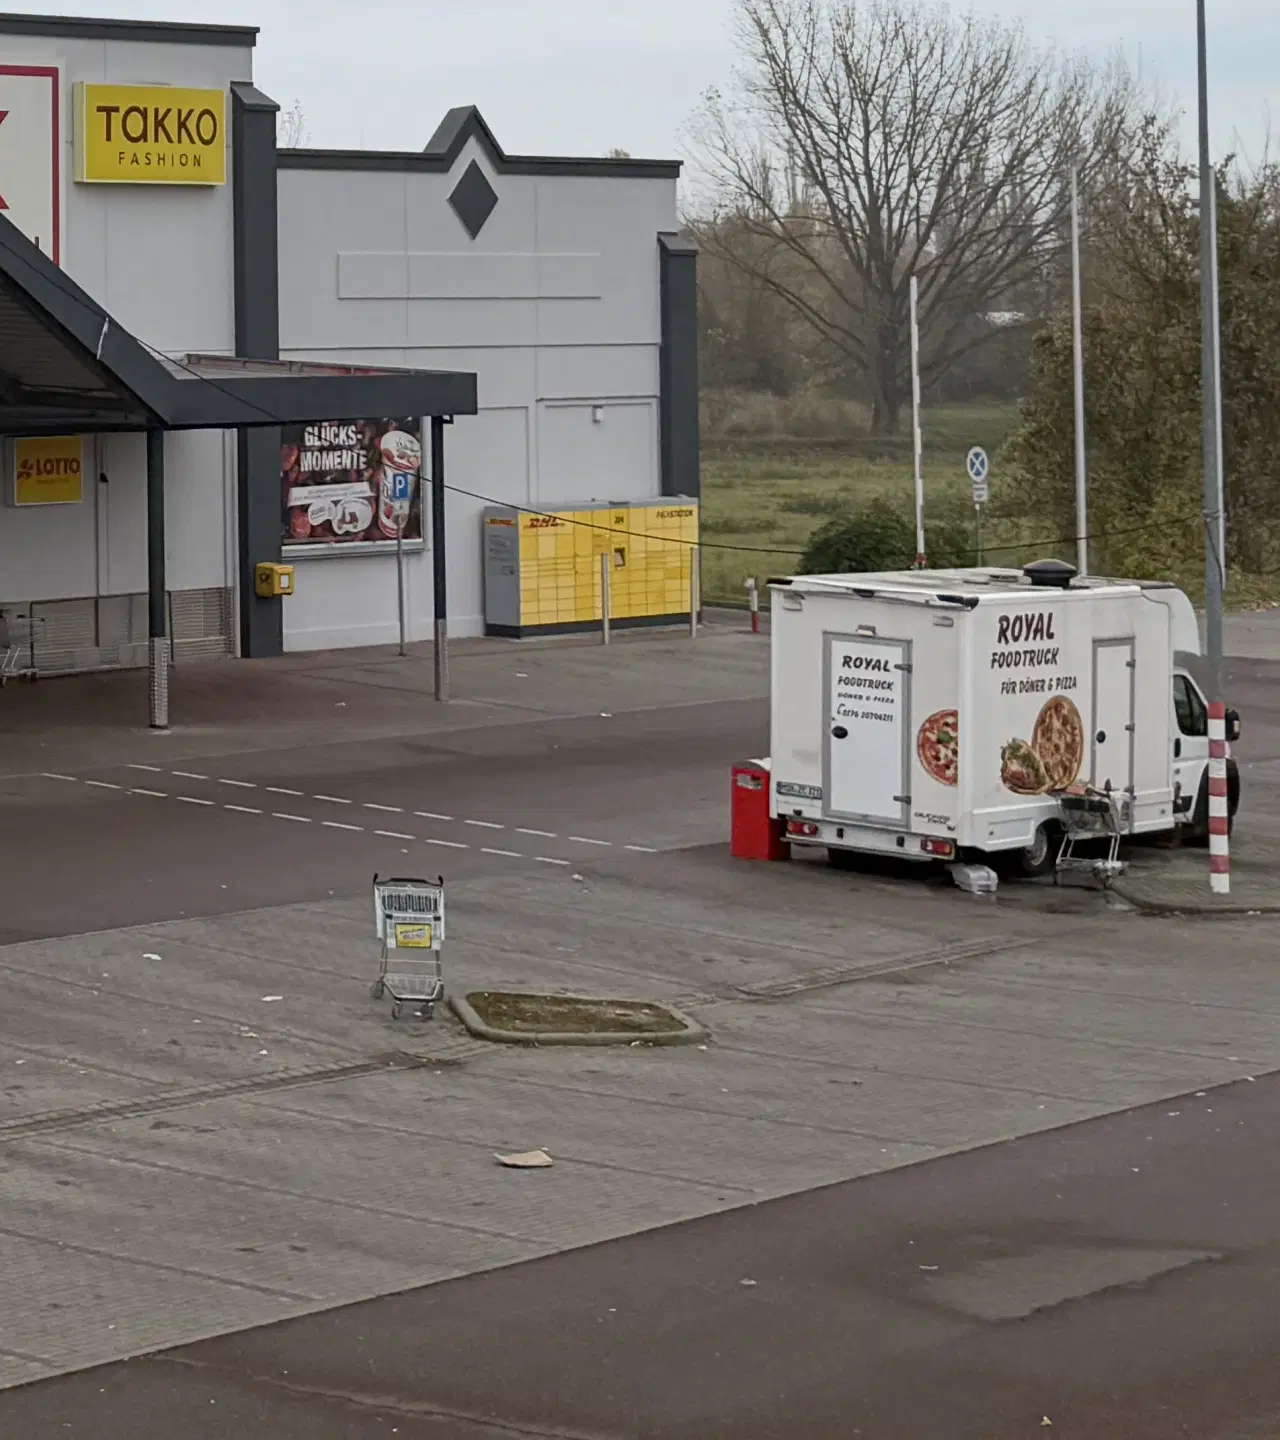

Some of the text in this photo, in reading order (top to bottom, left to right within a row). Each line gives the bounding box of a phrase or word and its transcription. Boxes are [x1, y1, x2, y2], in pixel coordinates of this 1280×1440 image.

[118, 151, 203, 168] FASHION
[36, 456, 81, 476] LOTTO
[300, 449, 368, 472] MOMENTE
[997, 612, 1055, 645] ROYAL
[842, 655, 891, 672] ROYAL
[990, 647, 1059, 669] FOODTRUCK
[837, 676, 894, 691] FOODTRUCK
[1001, 678, 1017, 695] FÜR
[1019, 677, 1045, 694] DÖNER
[1056, 676, 1077, 690] PIZZA
